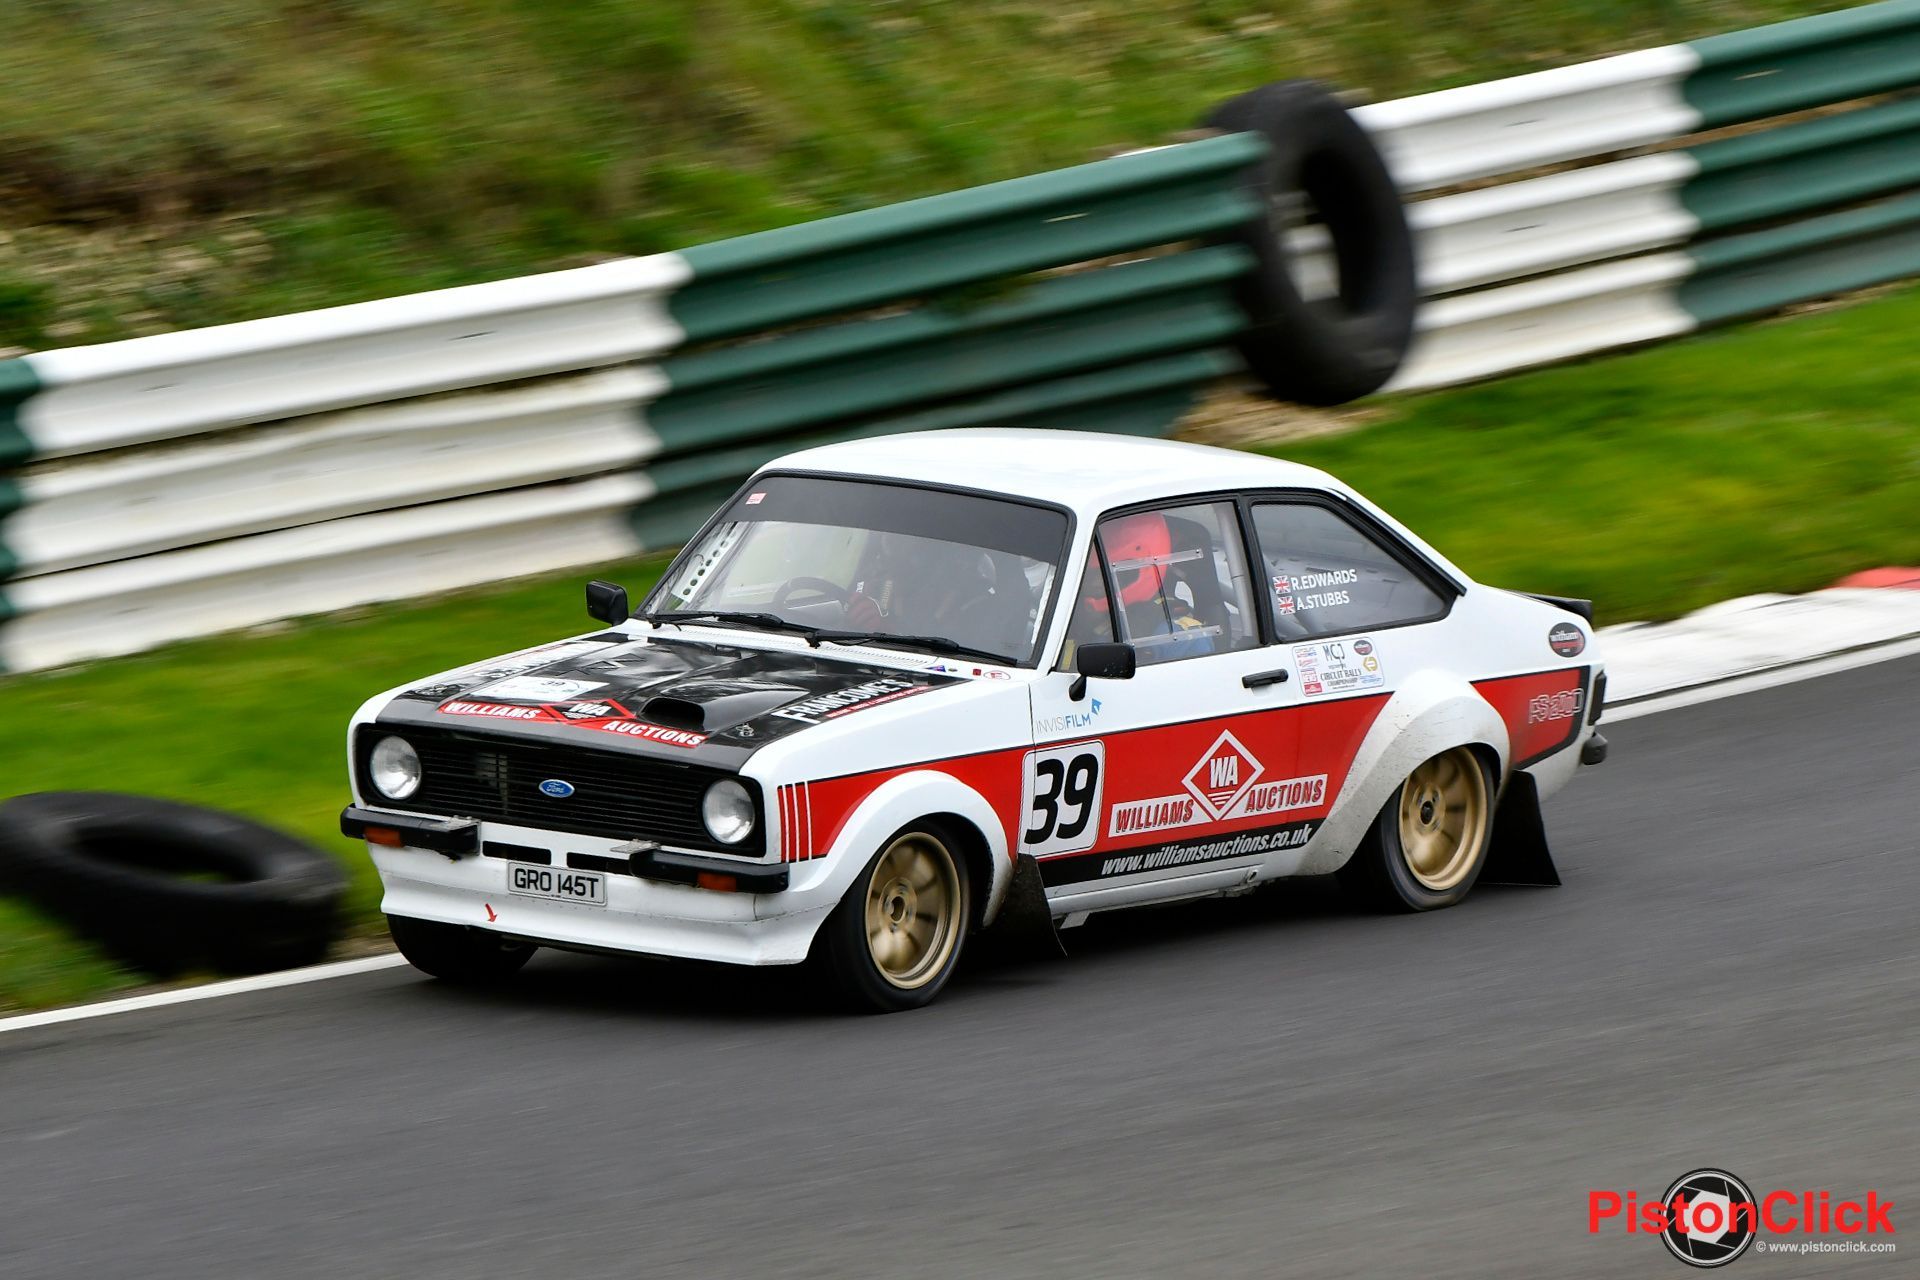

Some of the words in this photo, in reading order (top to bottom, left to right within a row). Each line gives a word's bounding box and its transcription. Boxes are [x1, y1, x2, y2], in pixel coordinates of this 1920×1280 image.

[1291, 568, 1358, 591] R.EDWARDS
[1297, 590, 1350, 611] A.STUBBS
[1320, 670, 1343, 681] CIRCUIT
[1344, 668, 1362, 679] RALLY
[568, 702, 612, 716] WA
[443, 702, 541, 720] WILLIAMS
[602, 720, 707, 746] AUCTIONS
[1036, 713, 1092, 734] INVISIFILM
[1209, 755, 1239, 789] WA
[546, 782, 565, 794] Ford
[1024, 753, 1099, 845] 39
[1115, 798, 1194, 834] WILLIAMS
[1245, 779, 1324, 813] AUCTIONS
[1101, 823, 1313, 876] www.williamsauctions.co.uk
[514, 868, 552, 892] GRO
[557, 873, 599, 898] 145T
